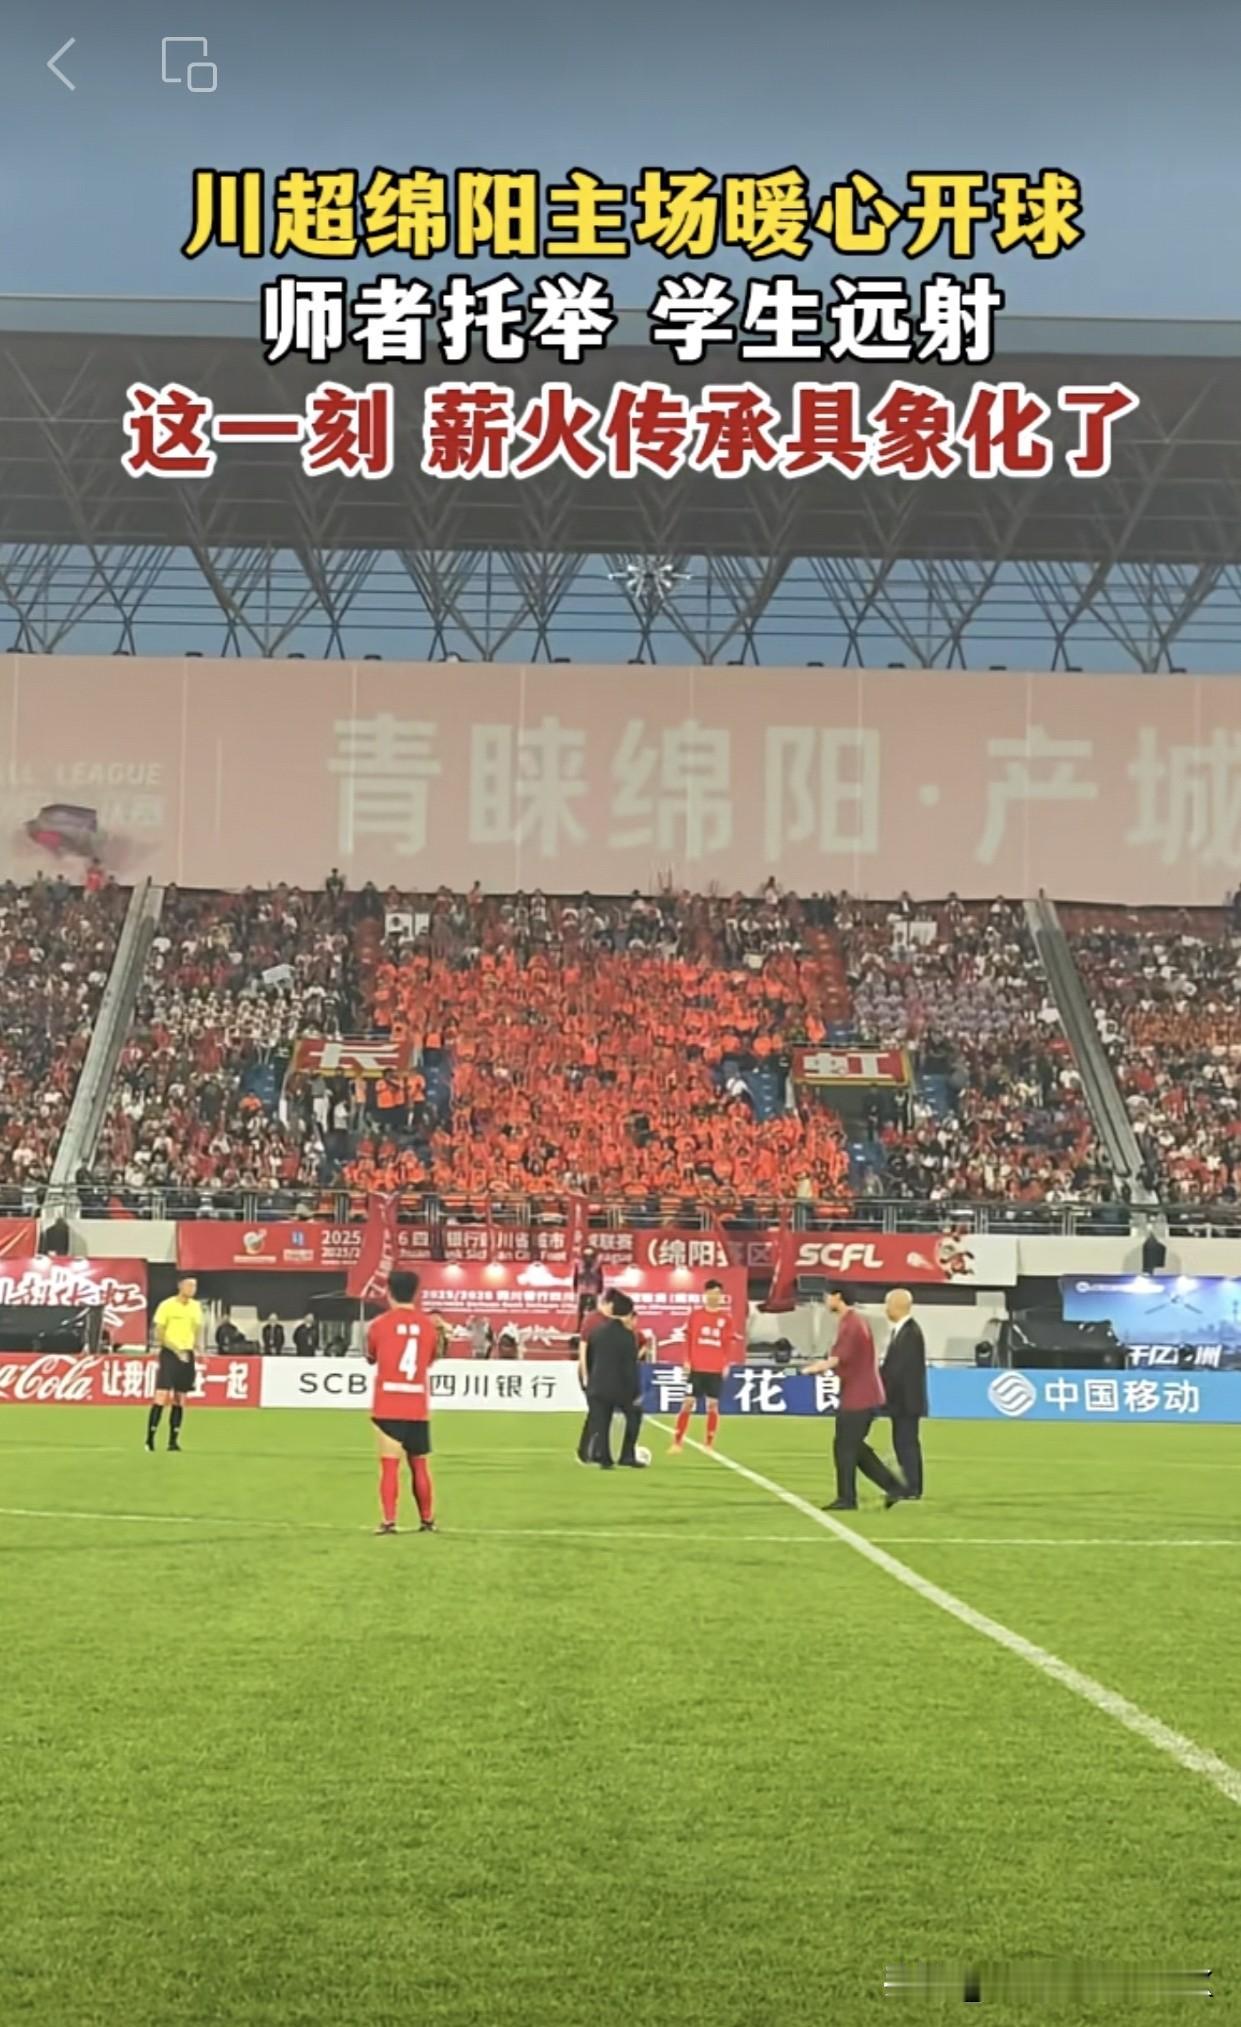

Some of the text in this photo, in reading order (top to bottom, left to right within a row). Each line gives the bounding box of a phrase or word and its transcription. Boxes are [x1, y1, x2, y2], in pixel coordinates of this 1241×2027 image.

[57, 762, 162, 785] LEAGUE
[796, 1243, 884, 1272] SCFL
[398, 1337, 418, 1381] 4
[300, 1373, 367, 1394] SCB
[430, 1373, 556, 1399] 四川银行
[1045, 1378, 1200, 1413] 中国移动
